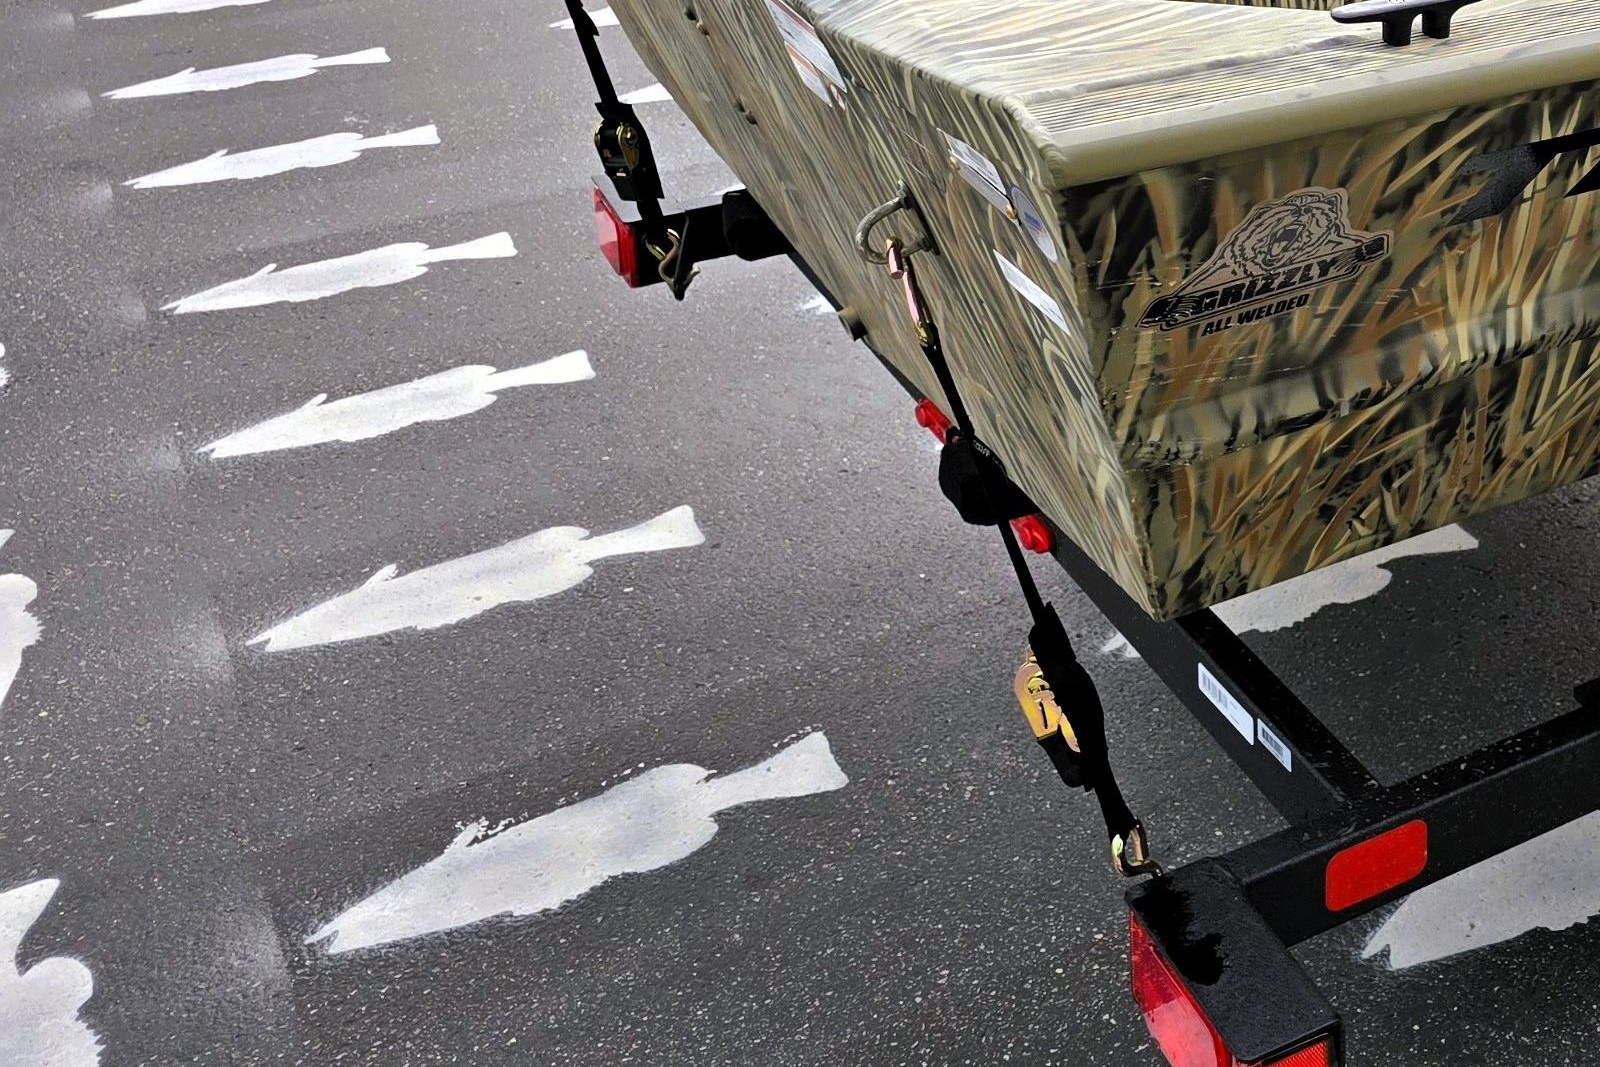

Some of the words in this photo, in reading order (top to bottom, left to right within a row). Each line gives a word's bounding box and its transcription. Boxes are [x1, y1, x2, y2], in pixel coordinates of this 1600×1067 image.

[1197, 258, 1338, 315] GRIZZLY
[1202, 315, 1233, 337] ALL
[1236, 292, 1311, 326] WELDED
